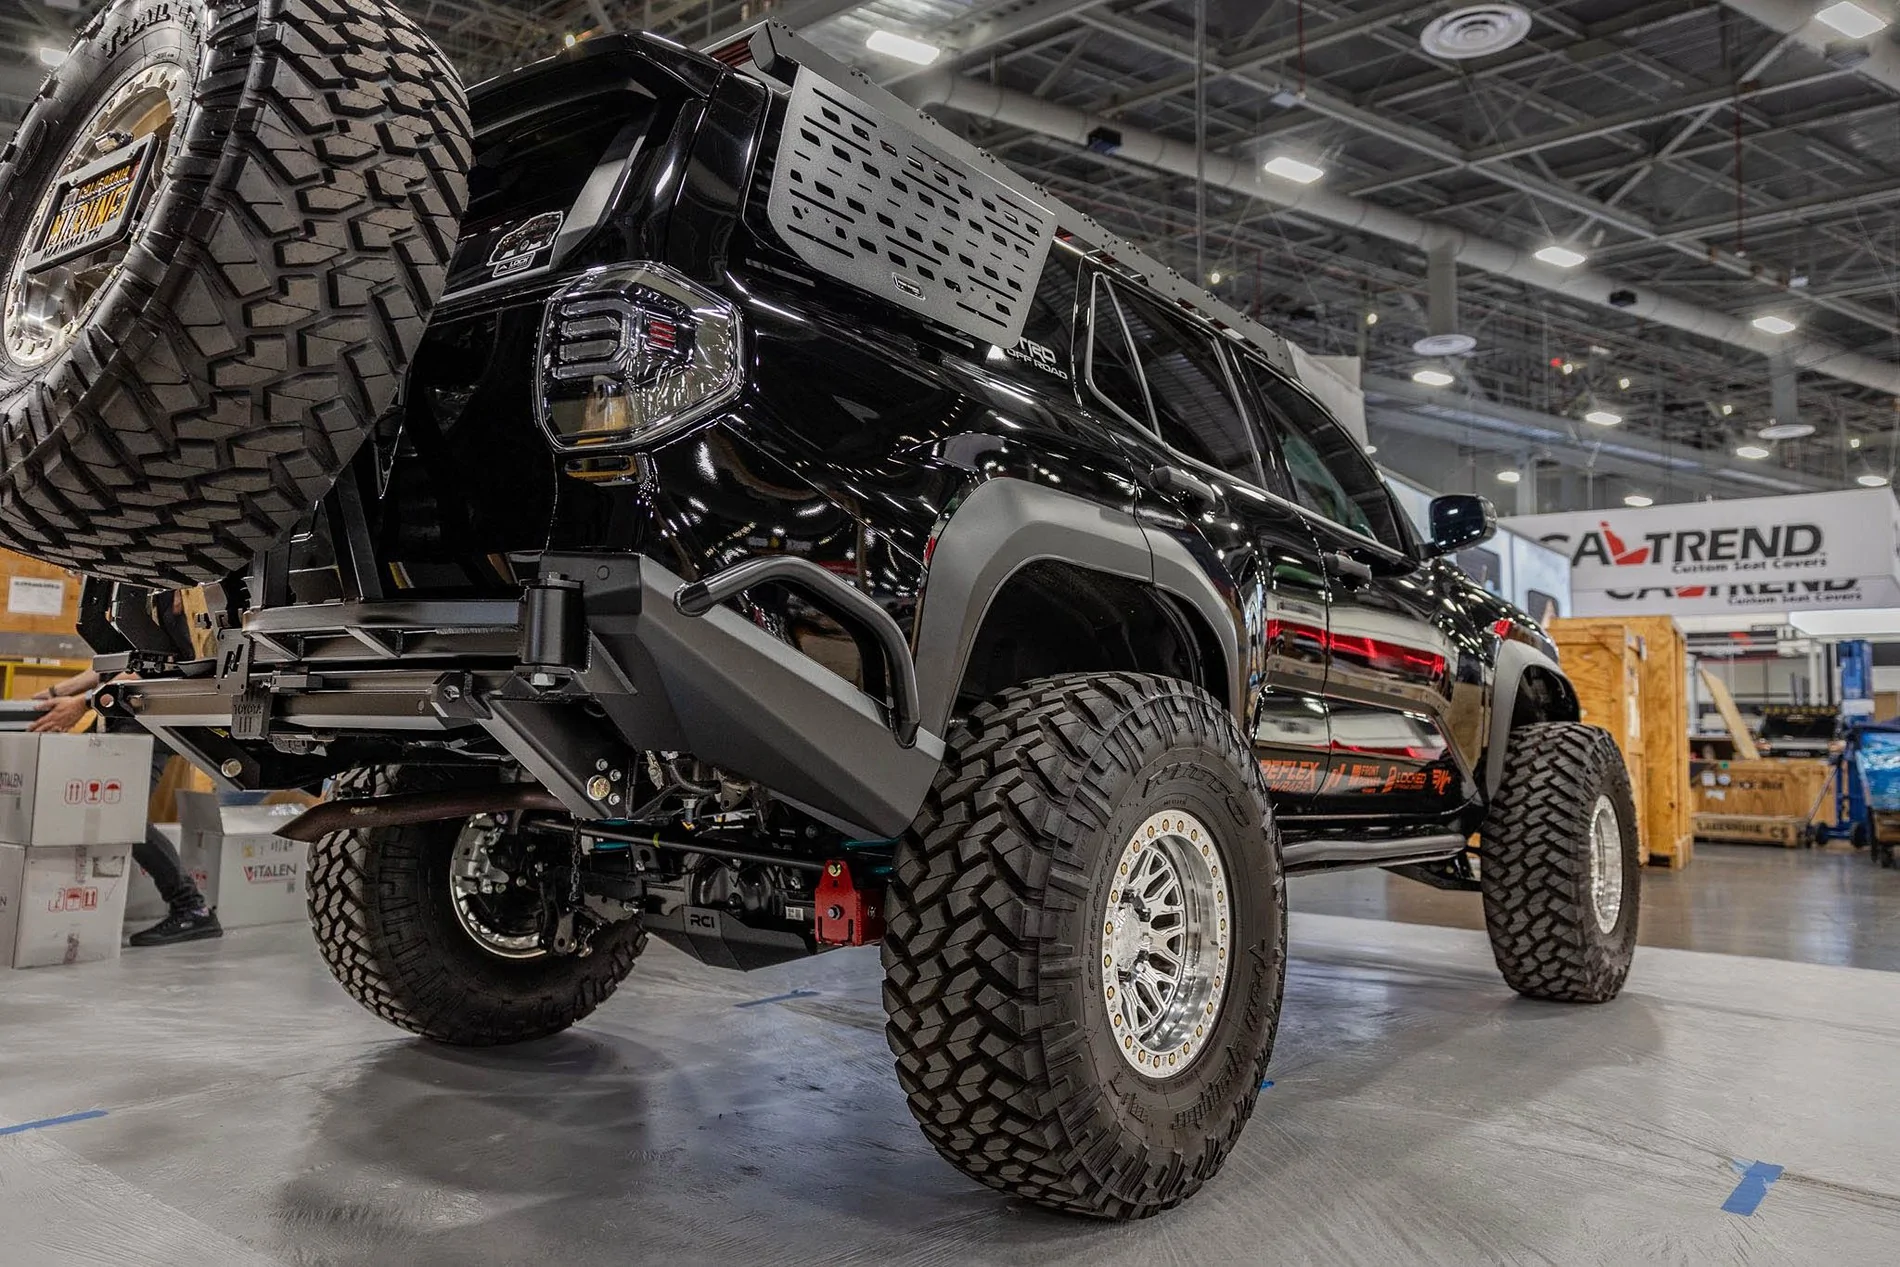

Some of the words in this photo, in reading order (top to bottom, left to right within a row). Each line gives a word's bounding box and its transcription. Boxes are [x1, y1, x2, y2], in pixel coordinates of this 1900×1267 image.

[1019, 336, 1057, 364] TRD
[1006, 348, 1032, 362] OFF
[1033, 359, 1068, 380] ROAD
[1773, 556, 1828, 569] Covers
[690, 914, 716, 928] RCI
